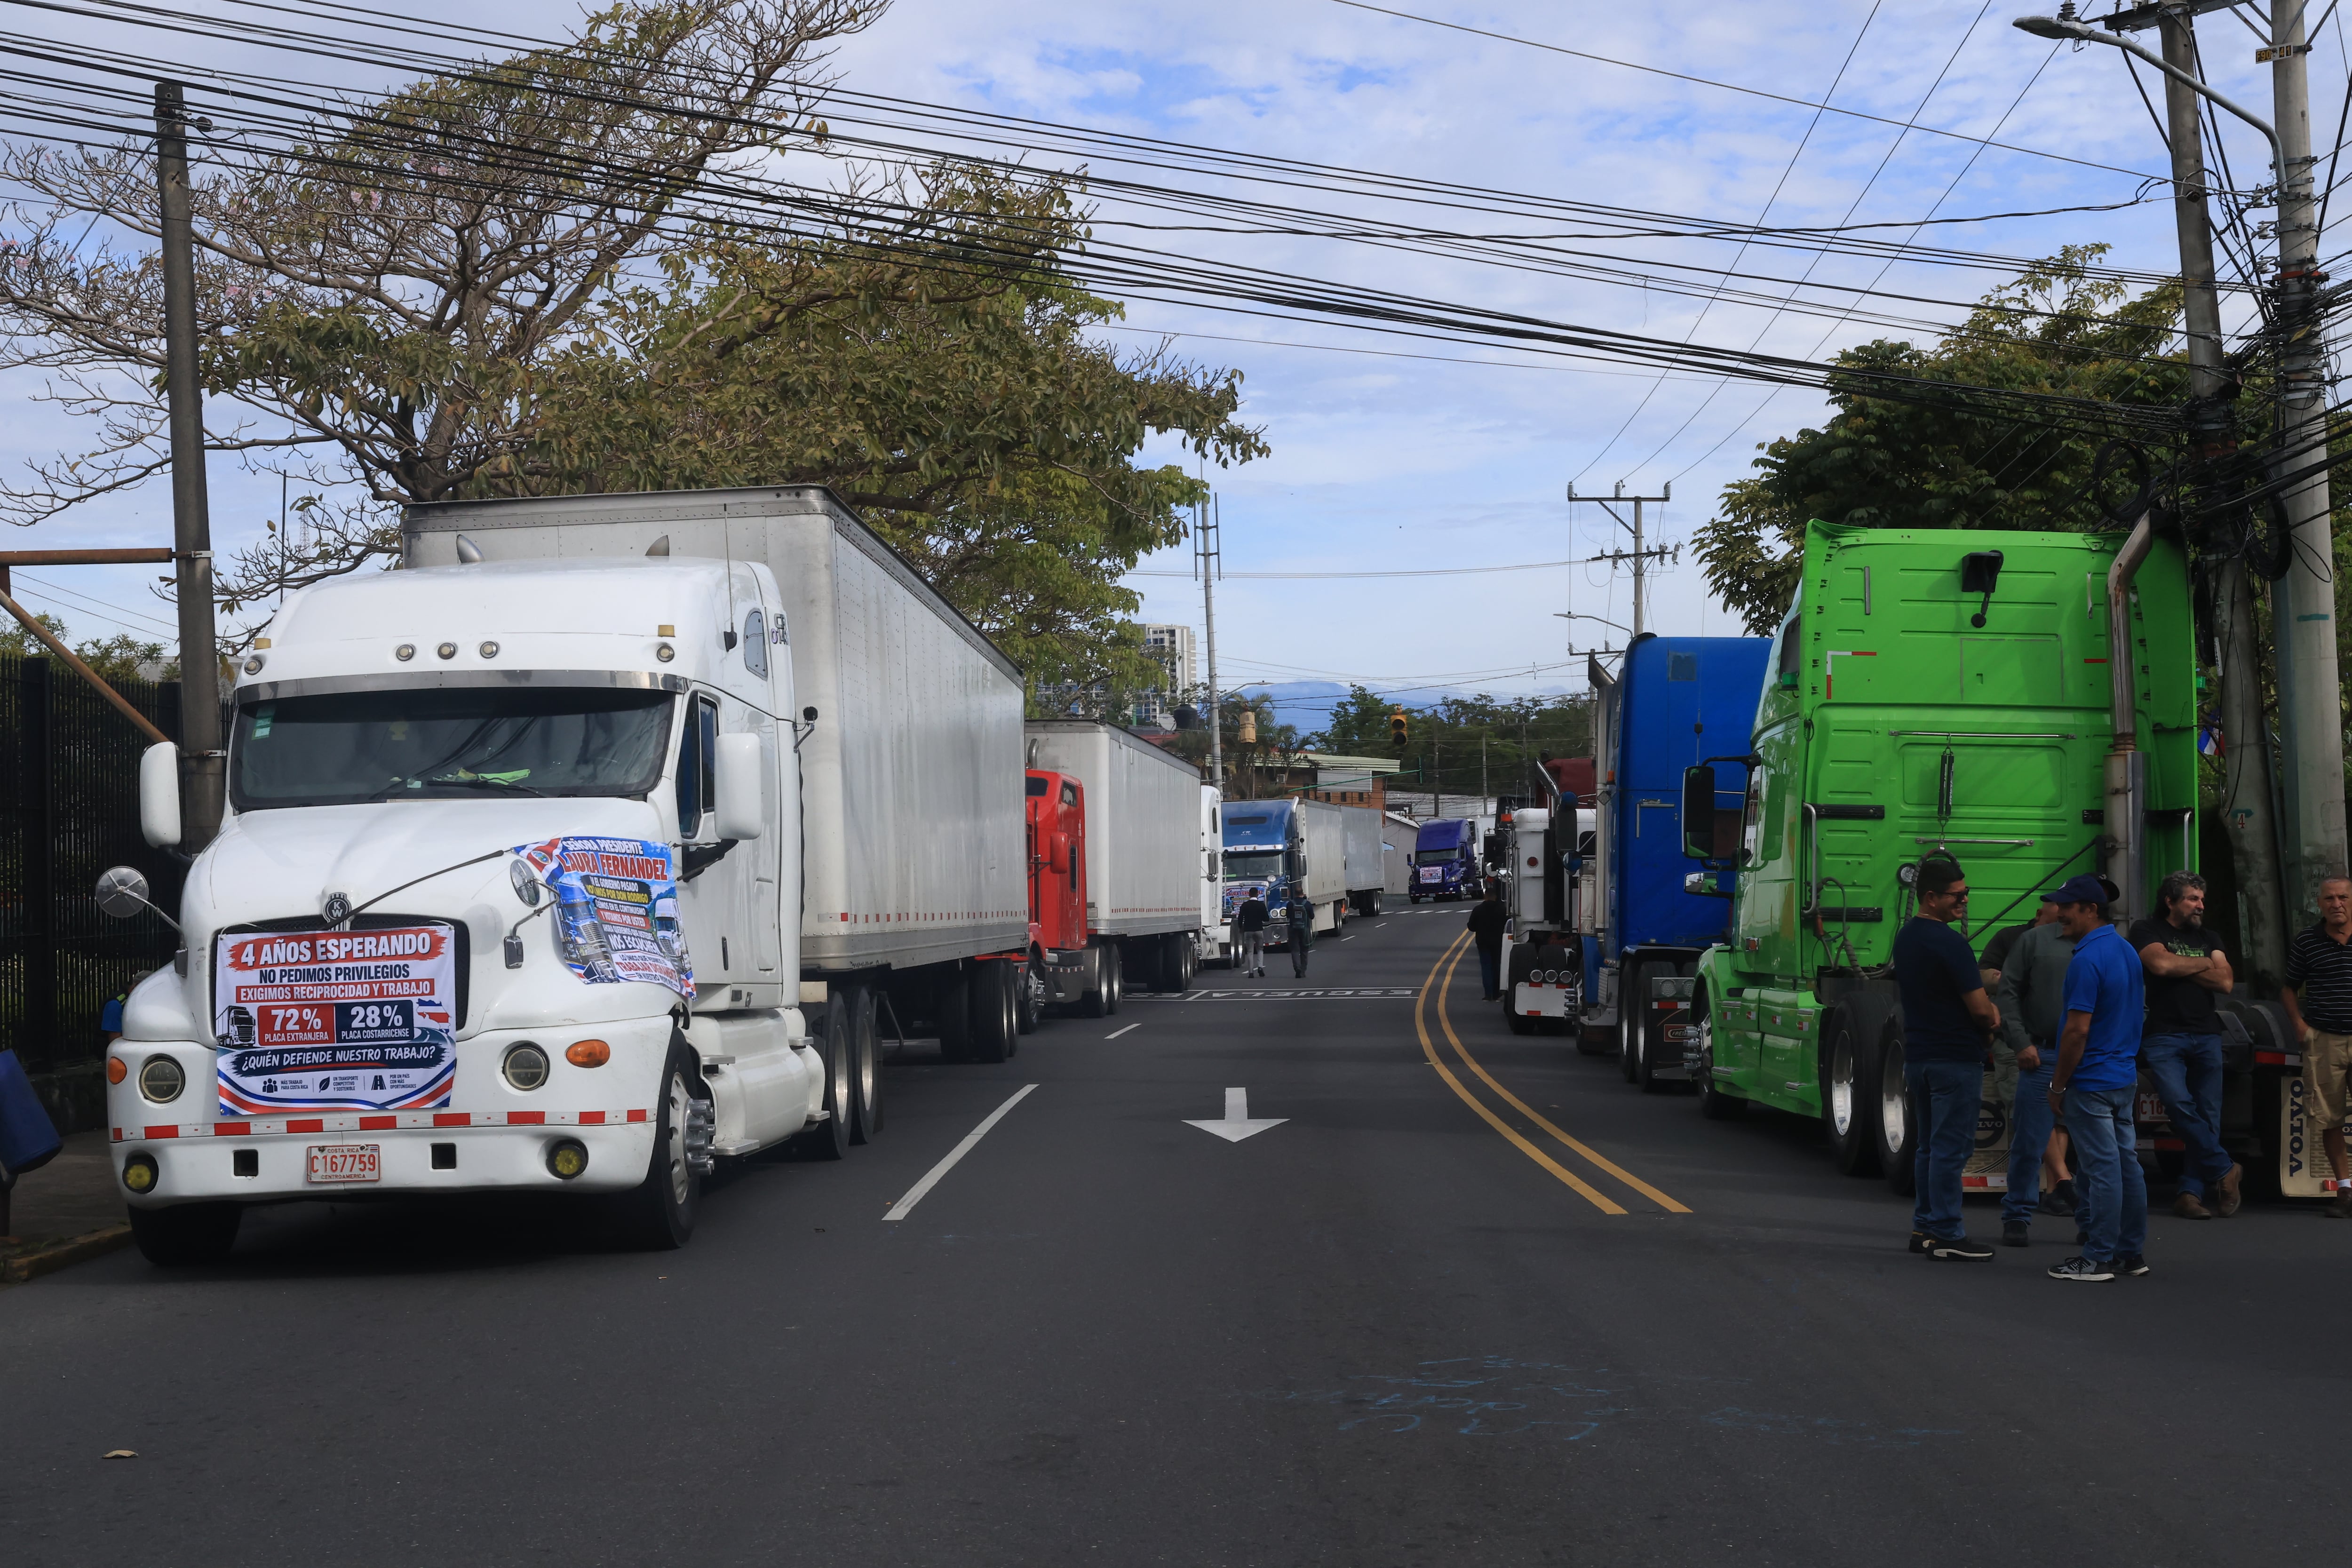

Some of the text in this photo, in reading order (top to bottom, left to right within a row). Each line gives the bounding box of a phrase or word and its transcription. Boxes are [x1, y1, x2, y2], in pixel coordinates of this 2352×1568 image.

[2257, 46, 2290, 62] F90 41
[2238, 814, 2245, 828] 4
[562, 838, 644, 855] SEÑORA PRESIDENTE
[556, 852, 668, 881] LAURA FERNÁNDEZ
[600, 878, 620, 890] GOBIERNO
[620, 881, 639, 892] PASADO
[605, 889, 617, 899] POR
[616, 891, 628, 900] DON
[627, 892, 649, 903] RODRIGO
[331, 909, 343, 917] W
[619, 904, 646, 916] CONTINUISMO
[622, 914, 633, 924] POR
[631, 916, 646, 927] USTED
[240, 932, 431, 967] 4 AÑOS ESPERANDO
[608, 934, 626, 950] NOS
[259, 964, 410, 984] NO PEDIMOS PRIVILEGIOS
[615, 962, 653, 972] TRABAJAR
[240, 981, 430, 1001] EXIGIMOS RECIPROCIDAD Y TRABAJO
[265, 1031, 329, 1043] PLACA EXTRANJERA
[342, 1028, 409, 1040] PLACA COSTARRICENSE
[242, 1046, 436, 1070] ¿QUIÉN DEFIENDE NUESTRO TRABAJO?
[2289, 1080, 2304, 1177] VOLVO
[311, 1154, 376, 1173] C167759
